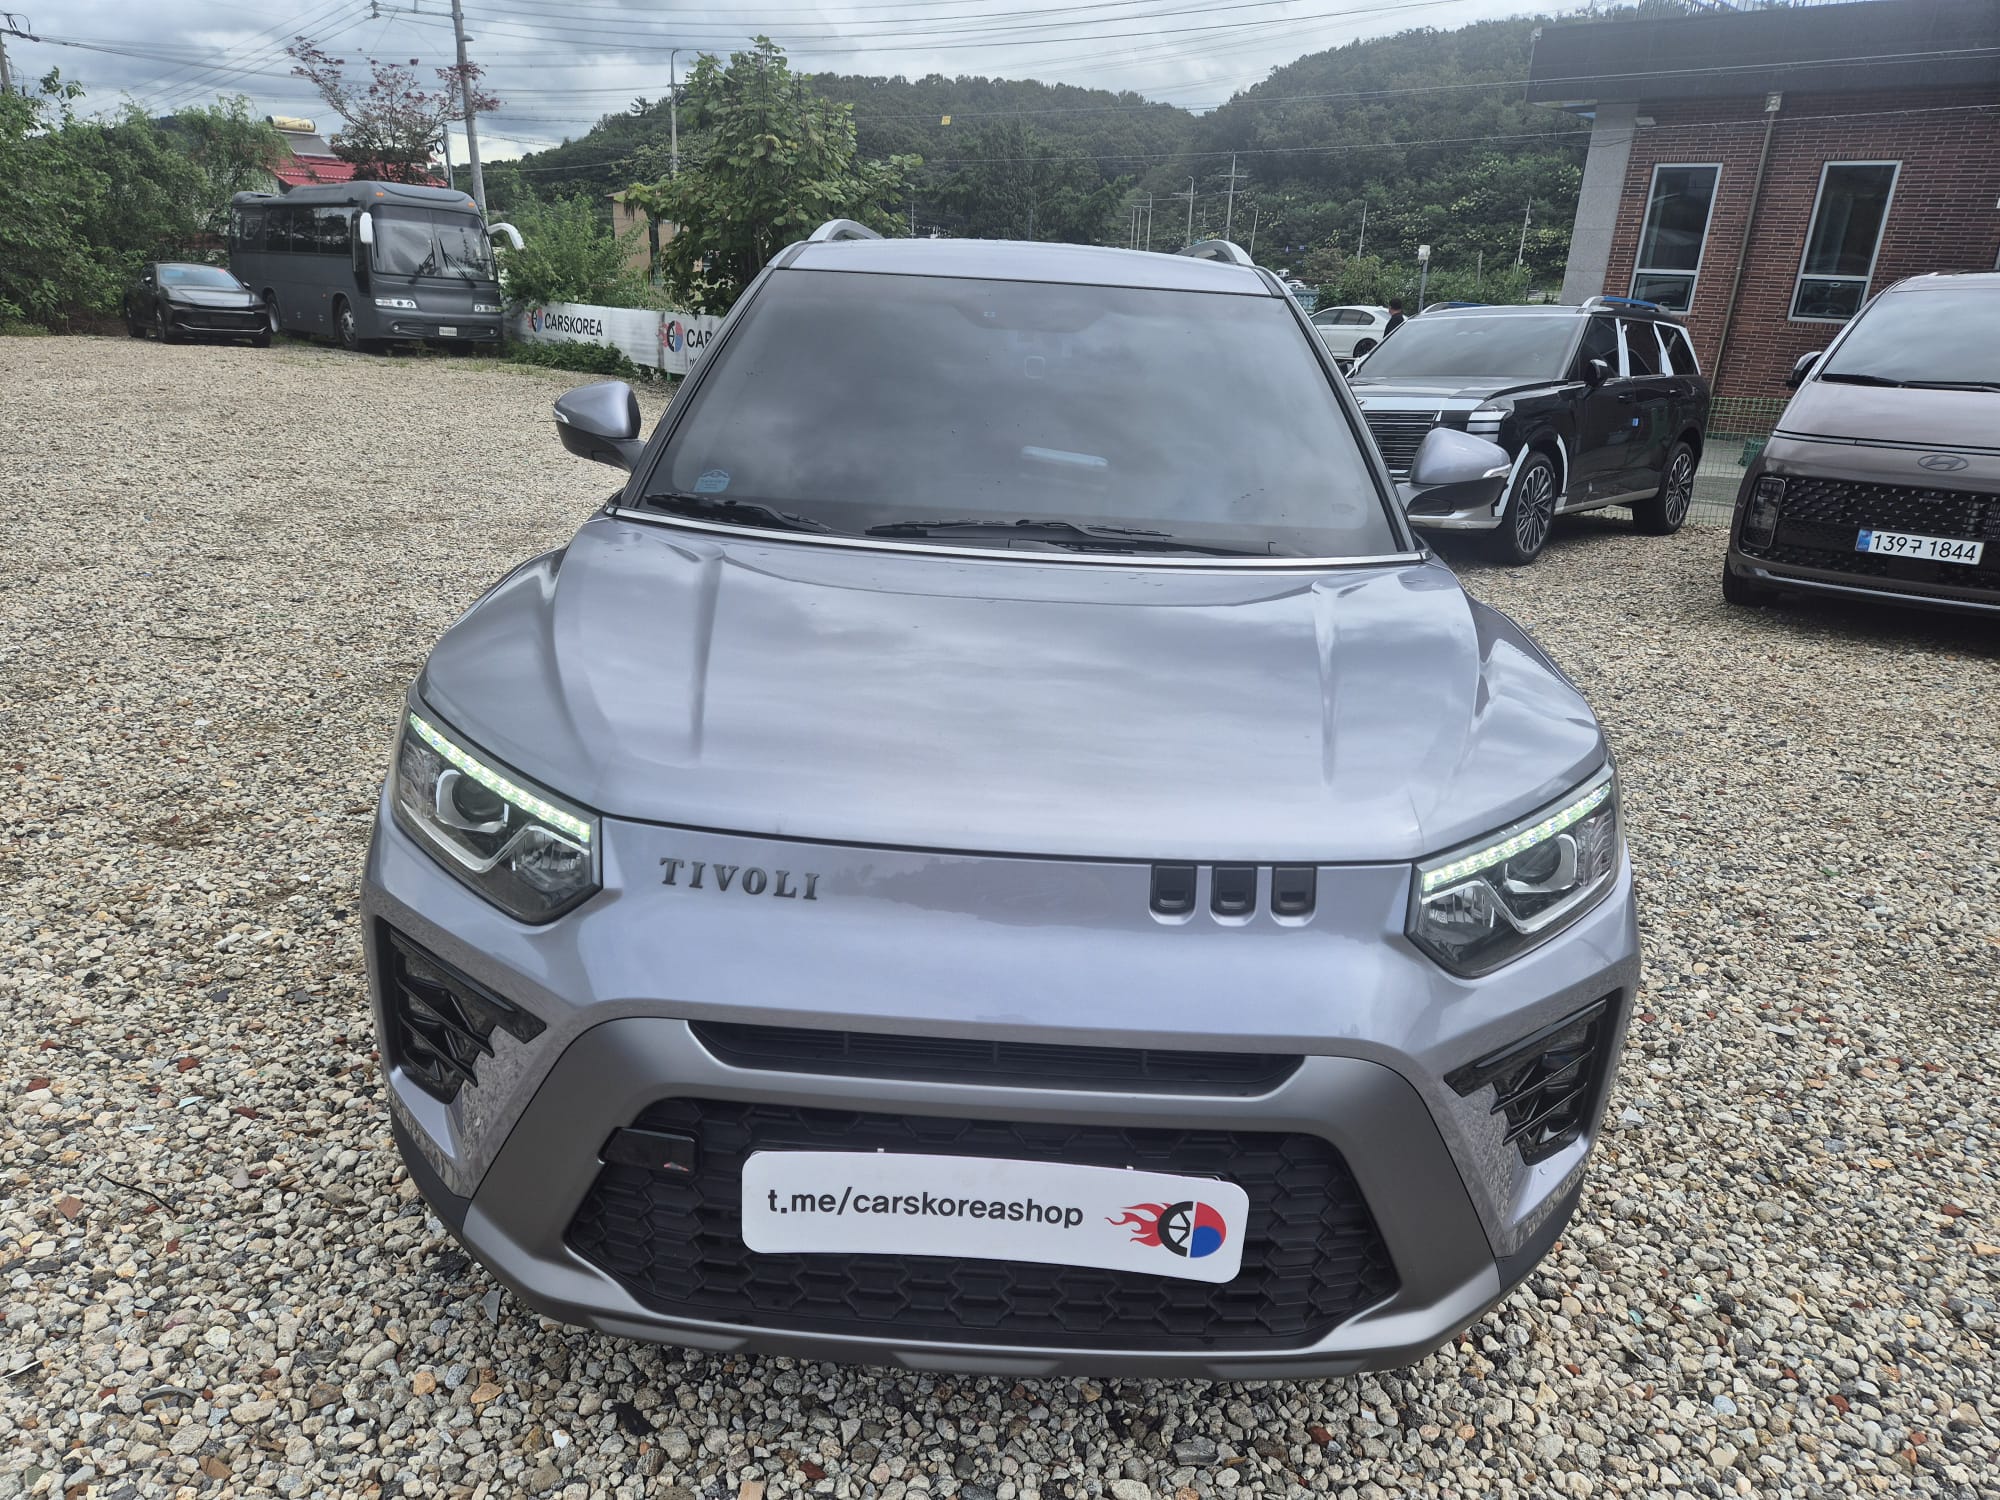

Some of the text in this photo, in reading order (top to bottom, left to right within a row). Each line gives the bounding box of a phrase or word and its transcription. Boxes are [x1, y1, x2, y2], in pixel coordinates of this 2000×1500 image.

[544, 313, 603, 337] CARSKOREA
[1874, 534, 1922, 554] 139구
[1929, 541, 1977, 560] 1844
[659, 857, 821, 900] TIVOLI
[767, 1186, 1084, 1229] t.me/carskoreashop
